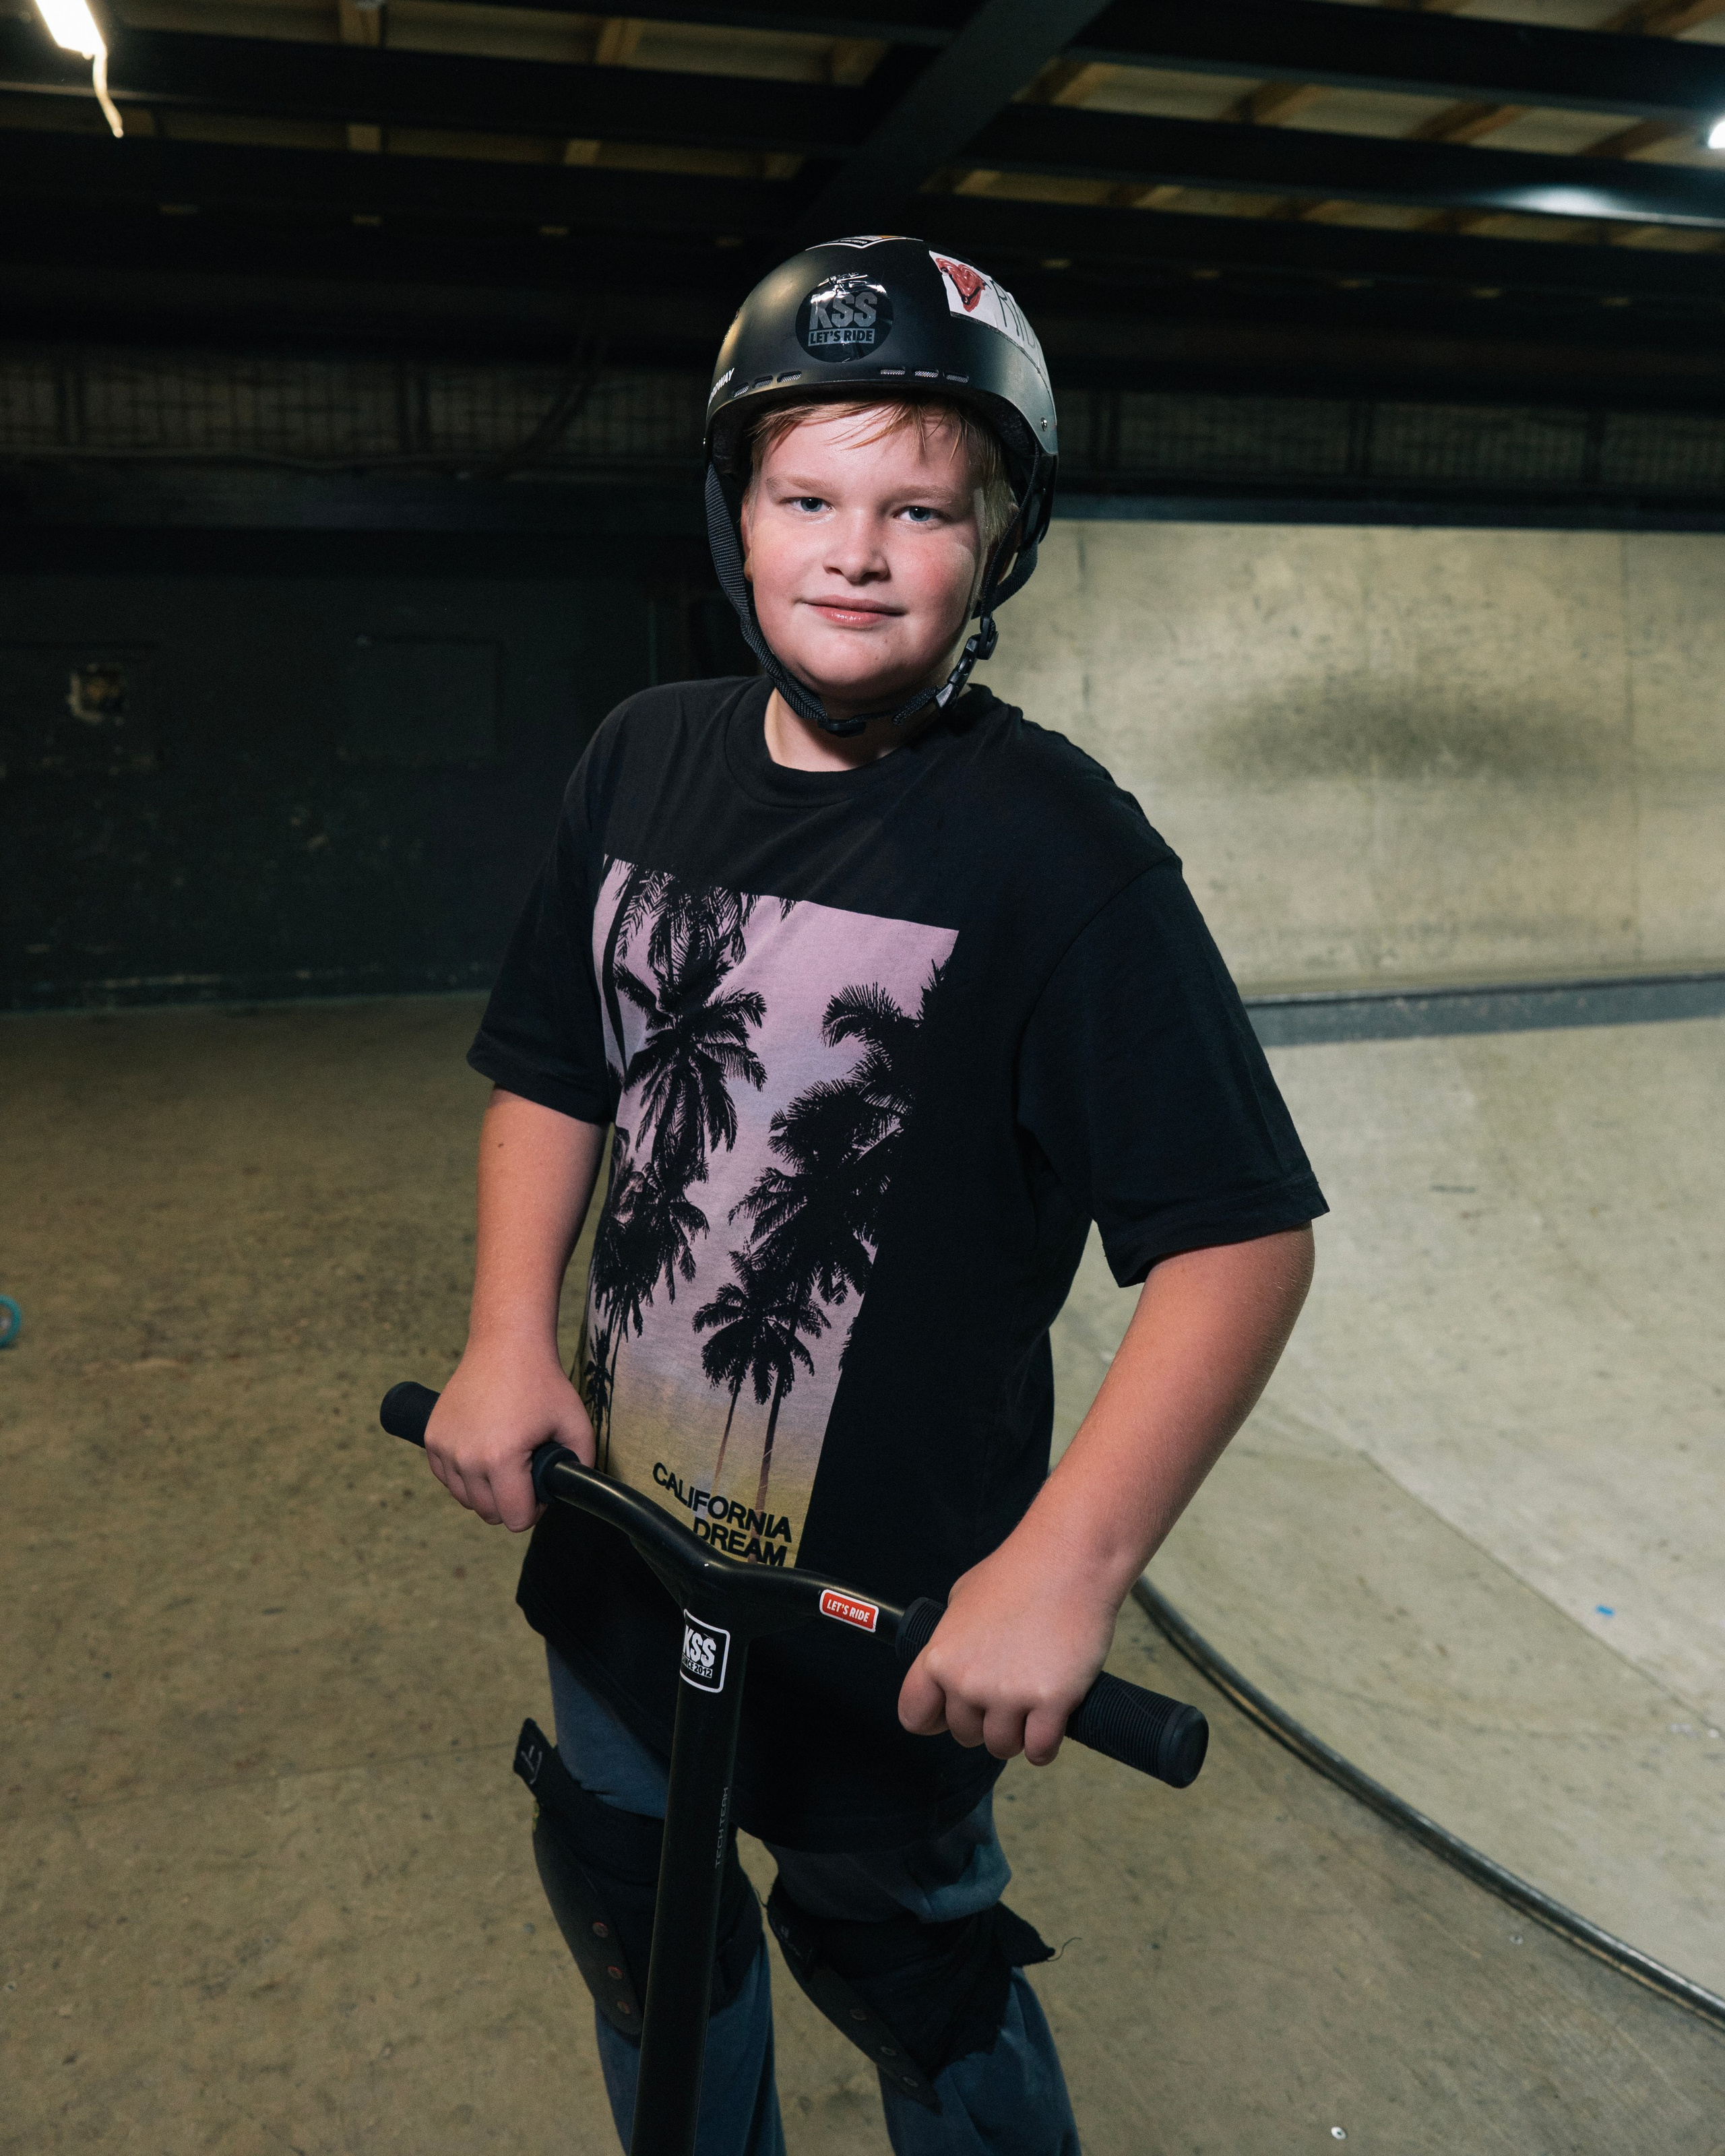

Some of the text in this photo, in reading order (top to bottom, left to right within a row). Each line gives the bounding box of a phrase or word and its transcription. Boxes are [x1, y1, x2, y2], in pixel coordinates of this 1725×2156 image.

[809, 292, 877, 330] KSS
[810, 329, 873, 344] LET'S RIDE
[652, 1462, 792, 1544] CALIFORNIA
[693, 1516, 788, 1566] DREAM
[827, 1599, 871, 1623] LET'S RIDE
[683, 1624, 716, 1668] KSS
[694, 1664, 712, 1677] 2012
[715, 1829, 724, 1869] TECH
